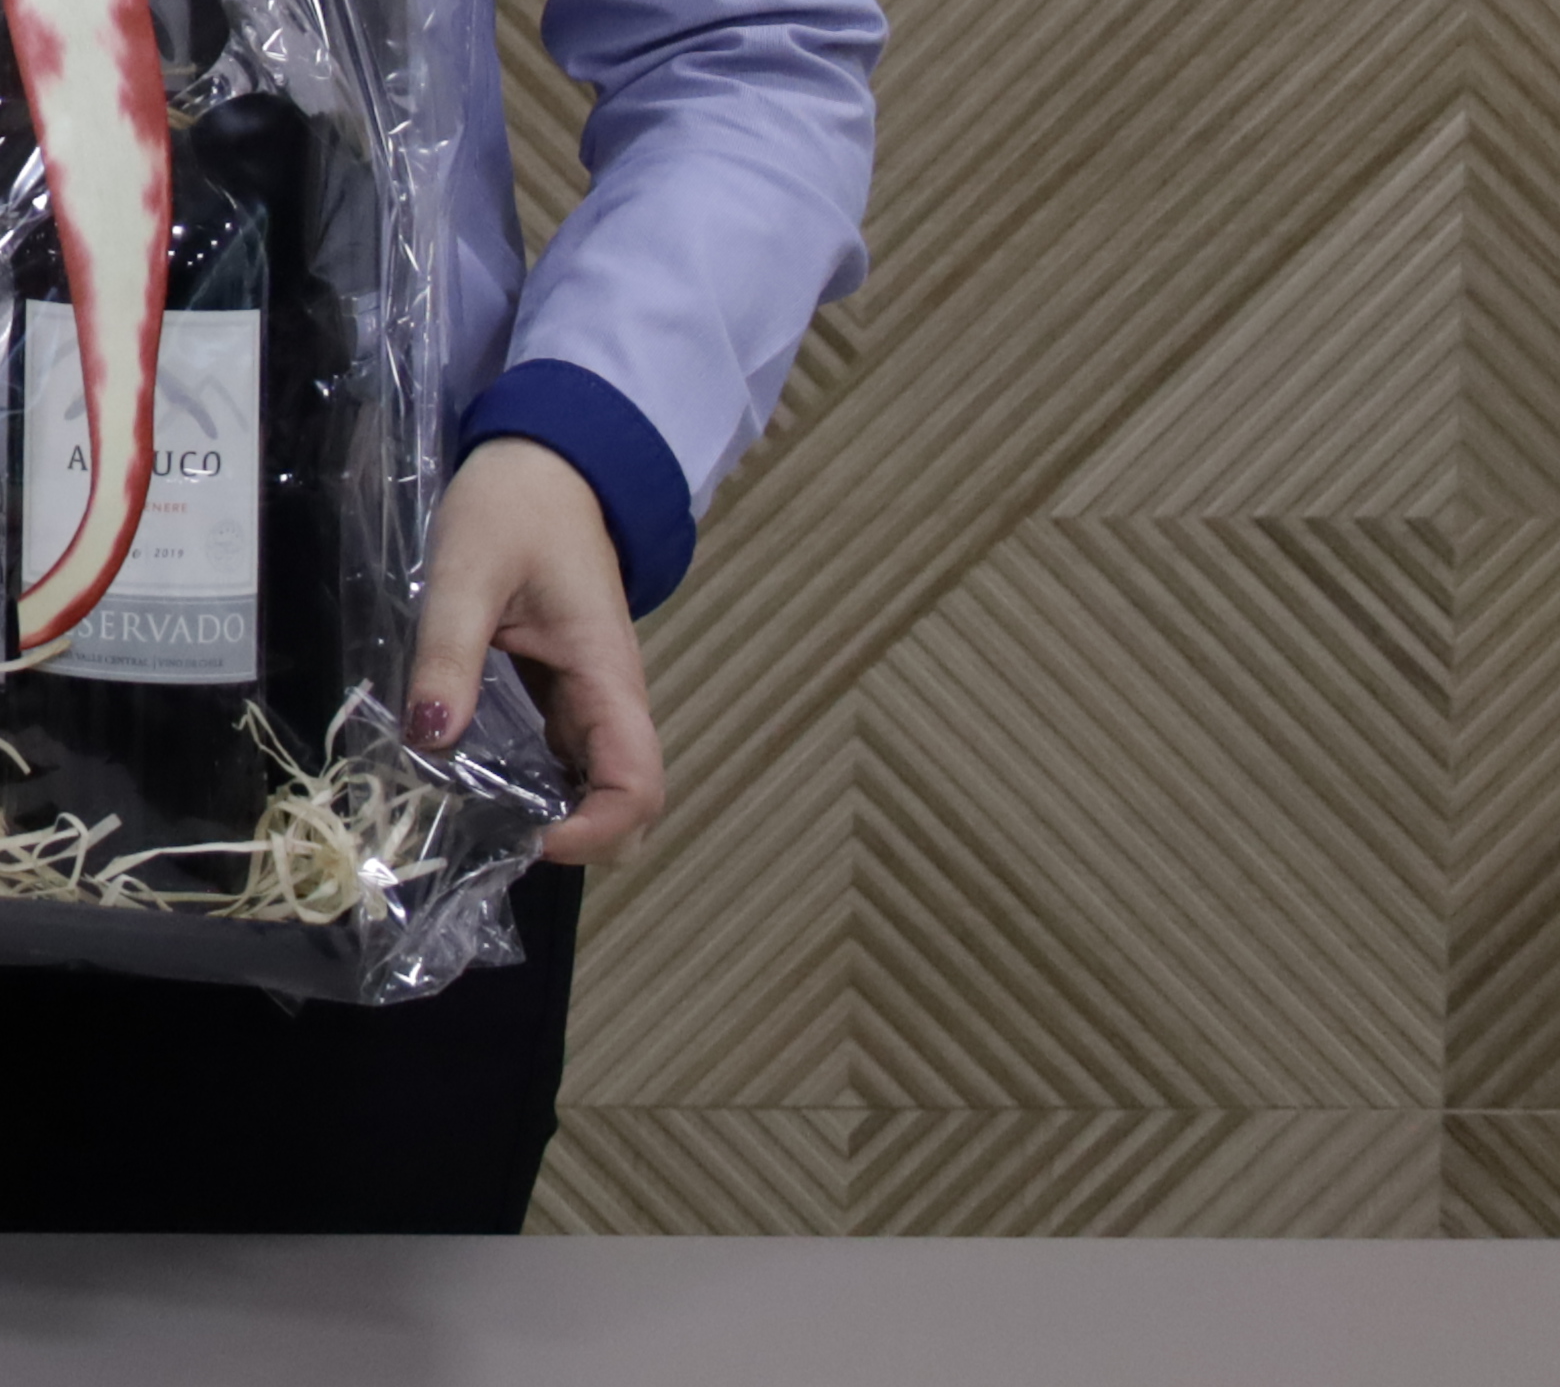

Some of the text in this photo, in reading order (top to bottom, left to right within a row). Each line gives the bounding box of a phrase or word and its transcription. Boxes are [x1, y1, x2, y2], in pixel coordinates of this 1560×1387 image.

[67, 444, 222, 478] AUCO
[153, 547, 185, 560] 2019
[65, 610, 245, 644] SERVADO
